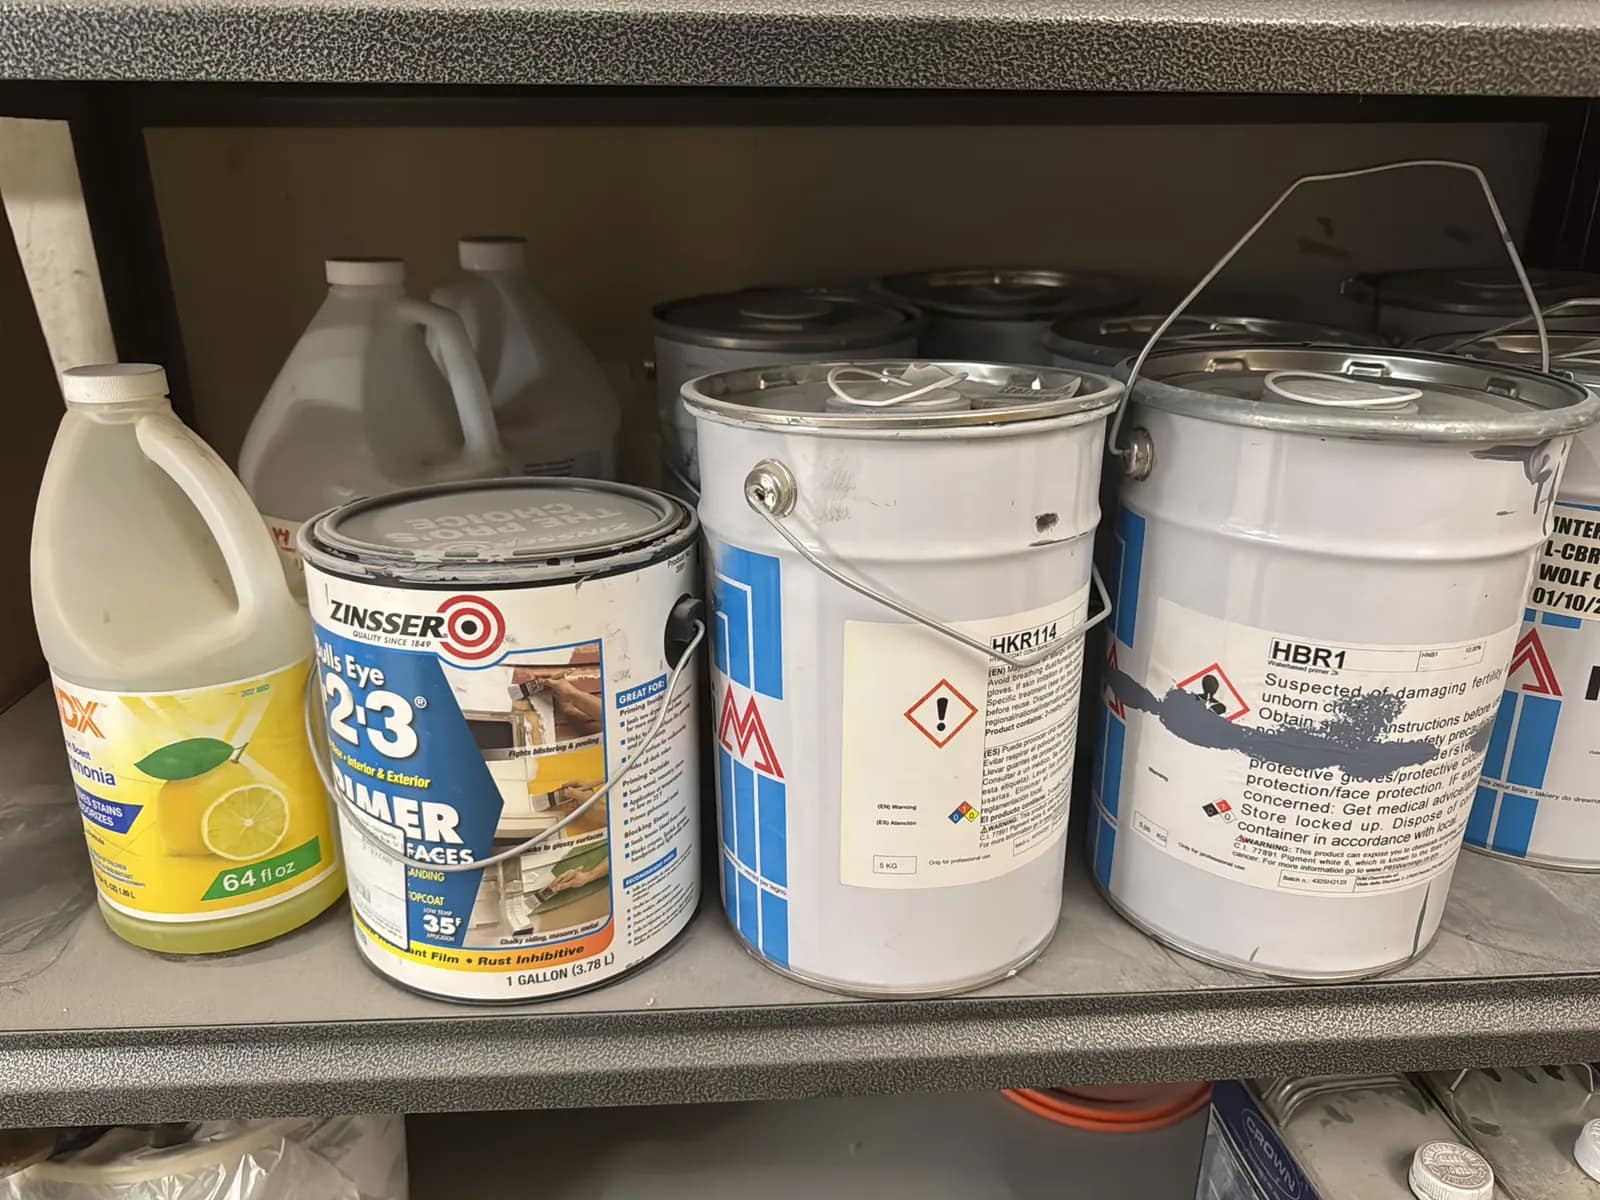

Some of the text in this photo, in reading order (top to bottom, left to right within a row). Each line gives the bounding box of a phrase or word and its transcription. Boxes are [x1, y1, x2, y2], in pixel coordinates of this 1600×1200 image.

[1540, 563, 1592, 588] WOLF
[330, 599, 445, 639] ZINSSER
[352, 630, 432, 649] QUALITY SINCE 1849
[993, 622, 1057, 654] HKR114
[1271, 640, 1346, 670] HBR1
[345, 653, 385, 689] Eye
[619, 688, 647, 705] GREAT
[1265, 672, 1362, 699] Suspected
[1396, 681, 1467, 700] damaging
[1262, 692, 1318, 711] unborn
[985, 724, 1014, 736] Product
[1258, 706, 1313, 728] Obtain
[984, 749, 1000, 758] (ES)
[347, 755, 376, 777] Interior
[386, 770, 431, 788] Exterior
[1249, 758, 1333, 782] protective
[1246, 774, 1370, 800] protection/face
[1376, 781, 1444, 802] protection.
[1449, 772, 1459, 786] IF
[94, 800, 123, 818] STAINS
[1243, 789, 1429, 816] concerned: Get medical
[1240, 800, 1458, 834] Store locked up. Dispose of
[1237, 820, 1310, 843] container
[1313, 832, 1327, 846] in
[1331, 832, 1411, 847] accordance
[1414, 825, 1435, 841] with
[1245, 837, 1292, 853] WARNING:
[1295, 847, 1311, 856] This
[1314, 850, 1344, 859] product
[1363, 850, 1388, 859] expose
[1252, 846, 1277, 858] 77891
[1280, 853, 1317, 865] Pigment
[1319, 857, 1341, 866] white
[1355, 858, 1377, 867] which
[1232, 850, 1261, 863] cancer.
[1262, 857, 1277, 866] For
[1278, 861, 1298, 870] more
[1300, 864, 1344, 875] information
[223, 861, 296, 891] 64 fl oz
[431, 951, 460, 965] Film
[478, 955, 511, 967] Rust
[516, 945, 585, 965] Inhibitive
[506, 952, 615, 987] 1 GALLON (3.78 L)
[1246, 1116, 1296, 1193] CROWN
